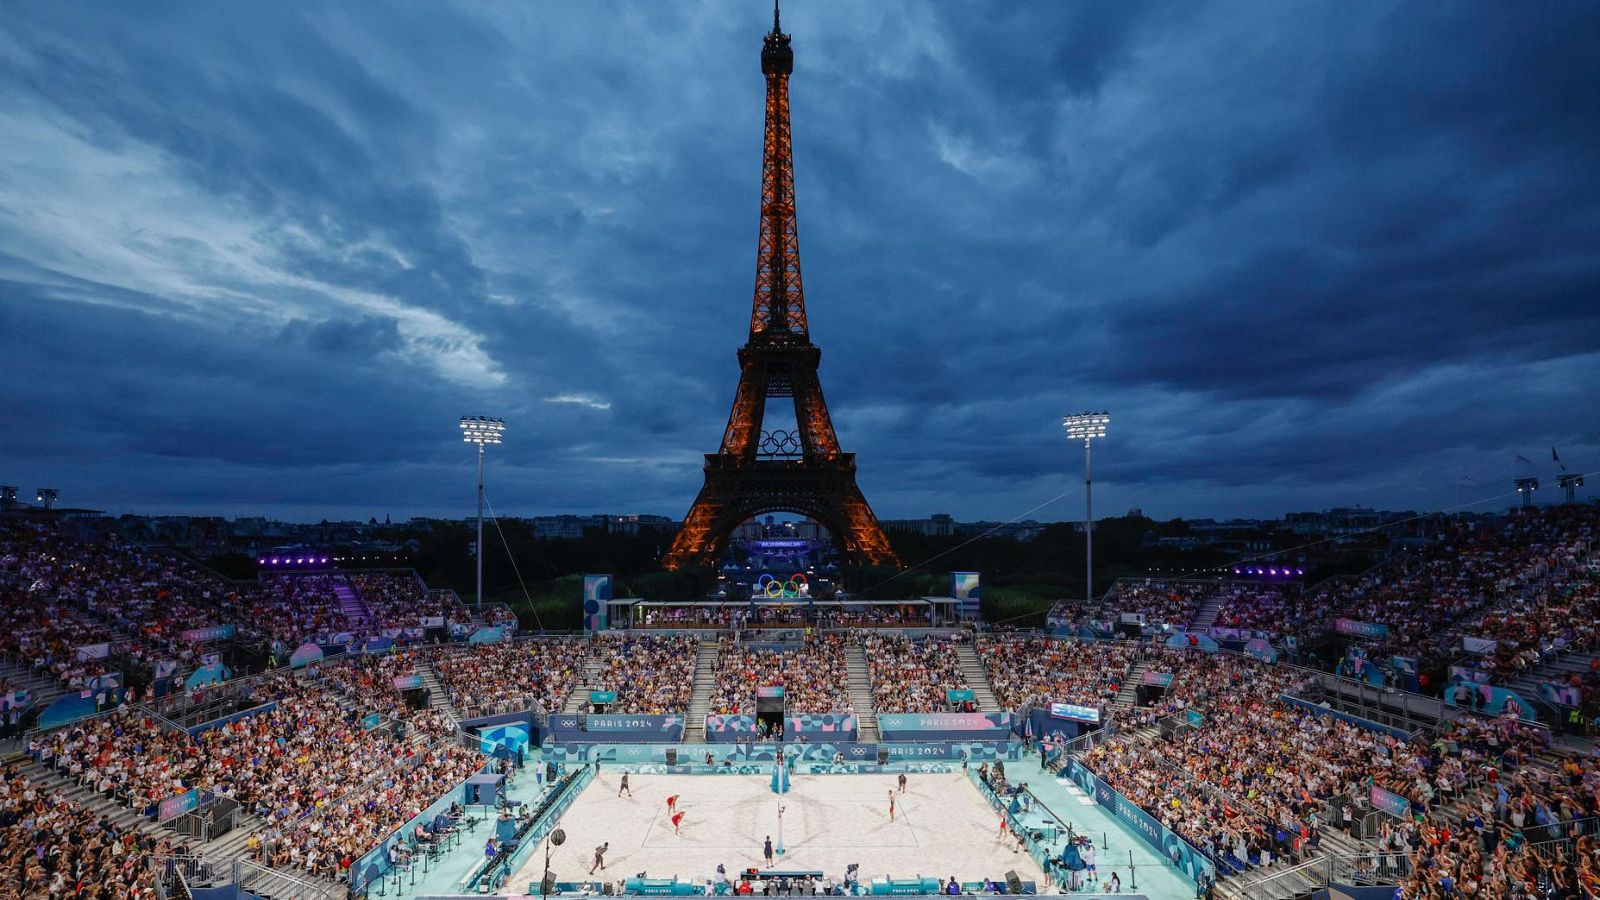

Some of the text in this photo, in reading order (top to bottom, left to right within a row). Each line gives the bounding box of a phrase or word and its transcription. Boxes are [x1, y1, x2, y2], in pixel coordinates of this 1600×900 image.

[920, 718, 978, 726] PARIS 2024
[917, 747, 945, 755] 2024
[1119, 803, 1158, 840] PARIS 2024
